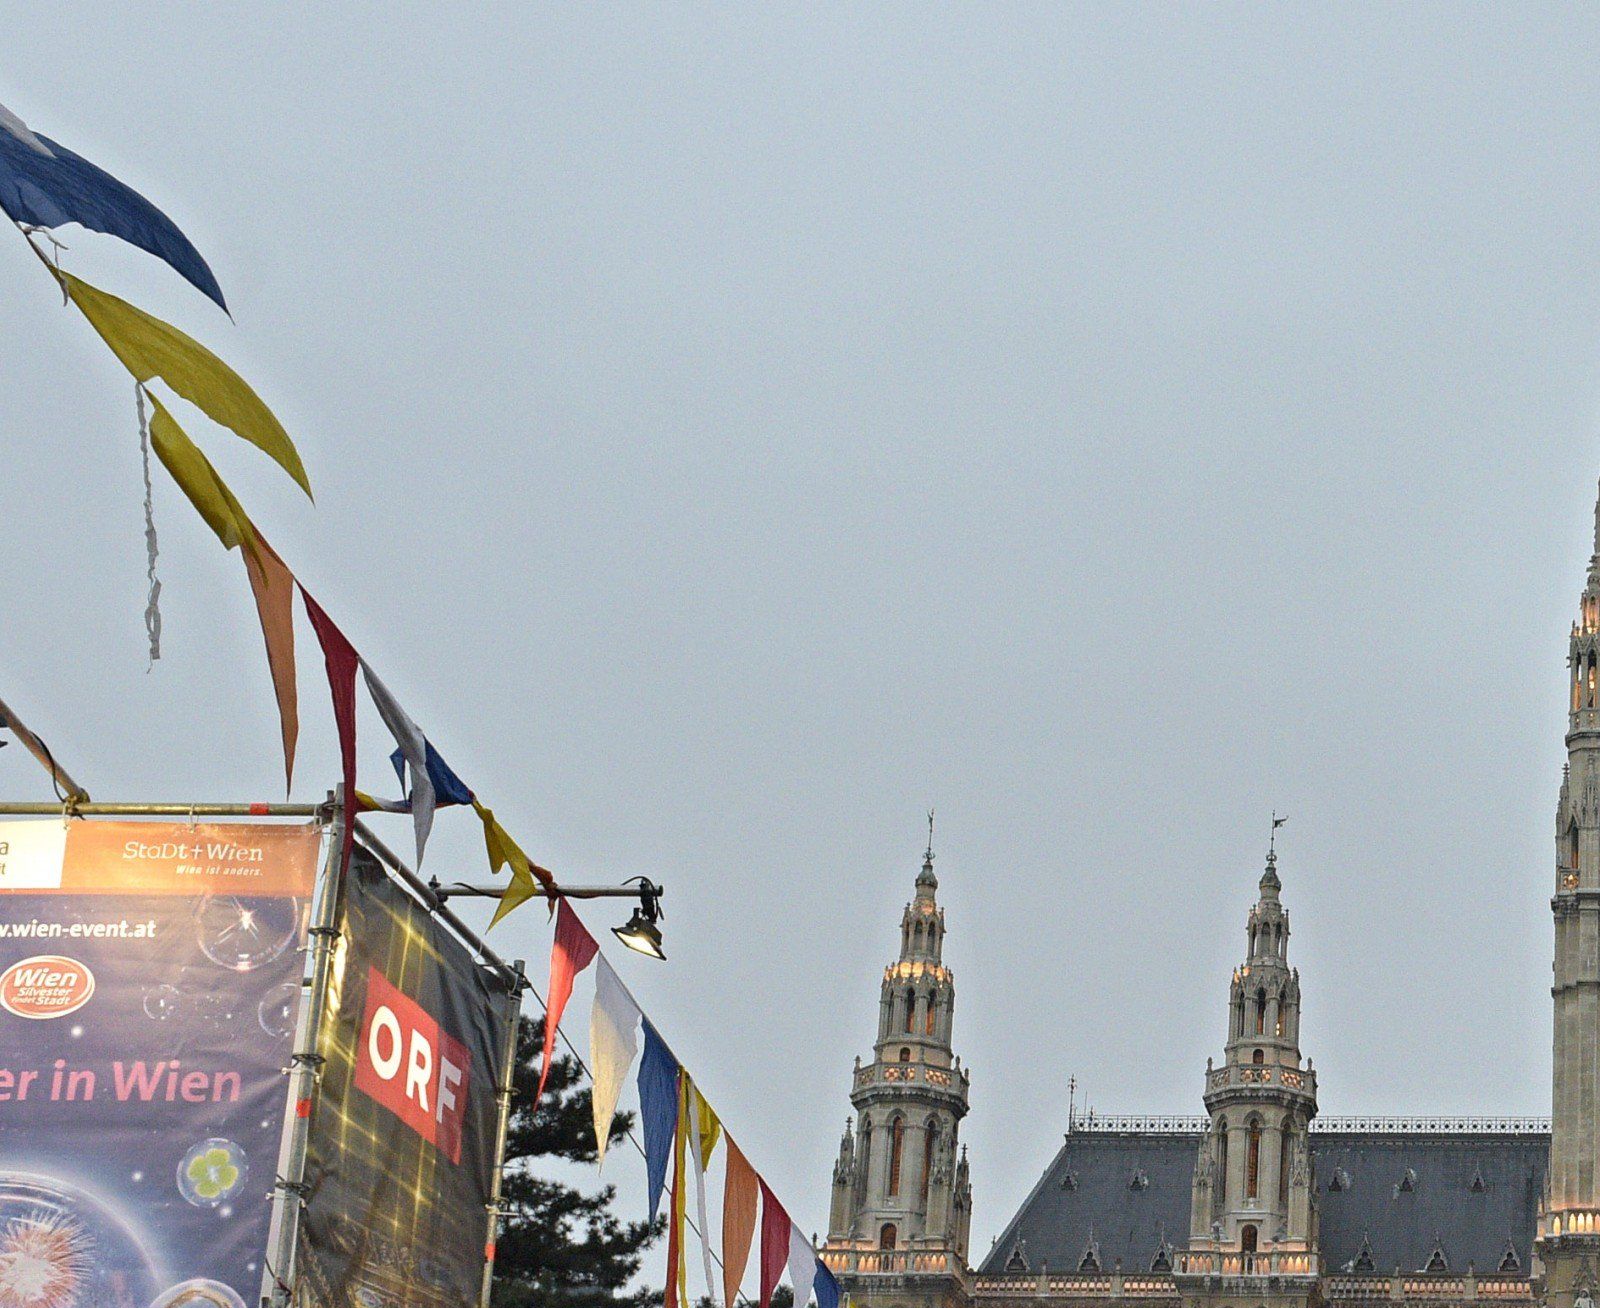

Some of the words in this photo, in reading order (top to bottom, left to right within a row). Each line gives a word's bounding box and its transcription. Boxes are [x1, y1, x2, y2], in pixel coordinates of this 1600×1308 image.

[13, 967, 78, 988] Wien
[17, 986, 73, 997] Silvester
[35, 995, 71, 1006] Stadt
[368, 1005, 463, 1125] ORF
[51, 1058, 96, 1101] in
[113, 1059, 242, 1103] Wien
